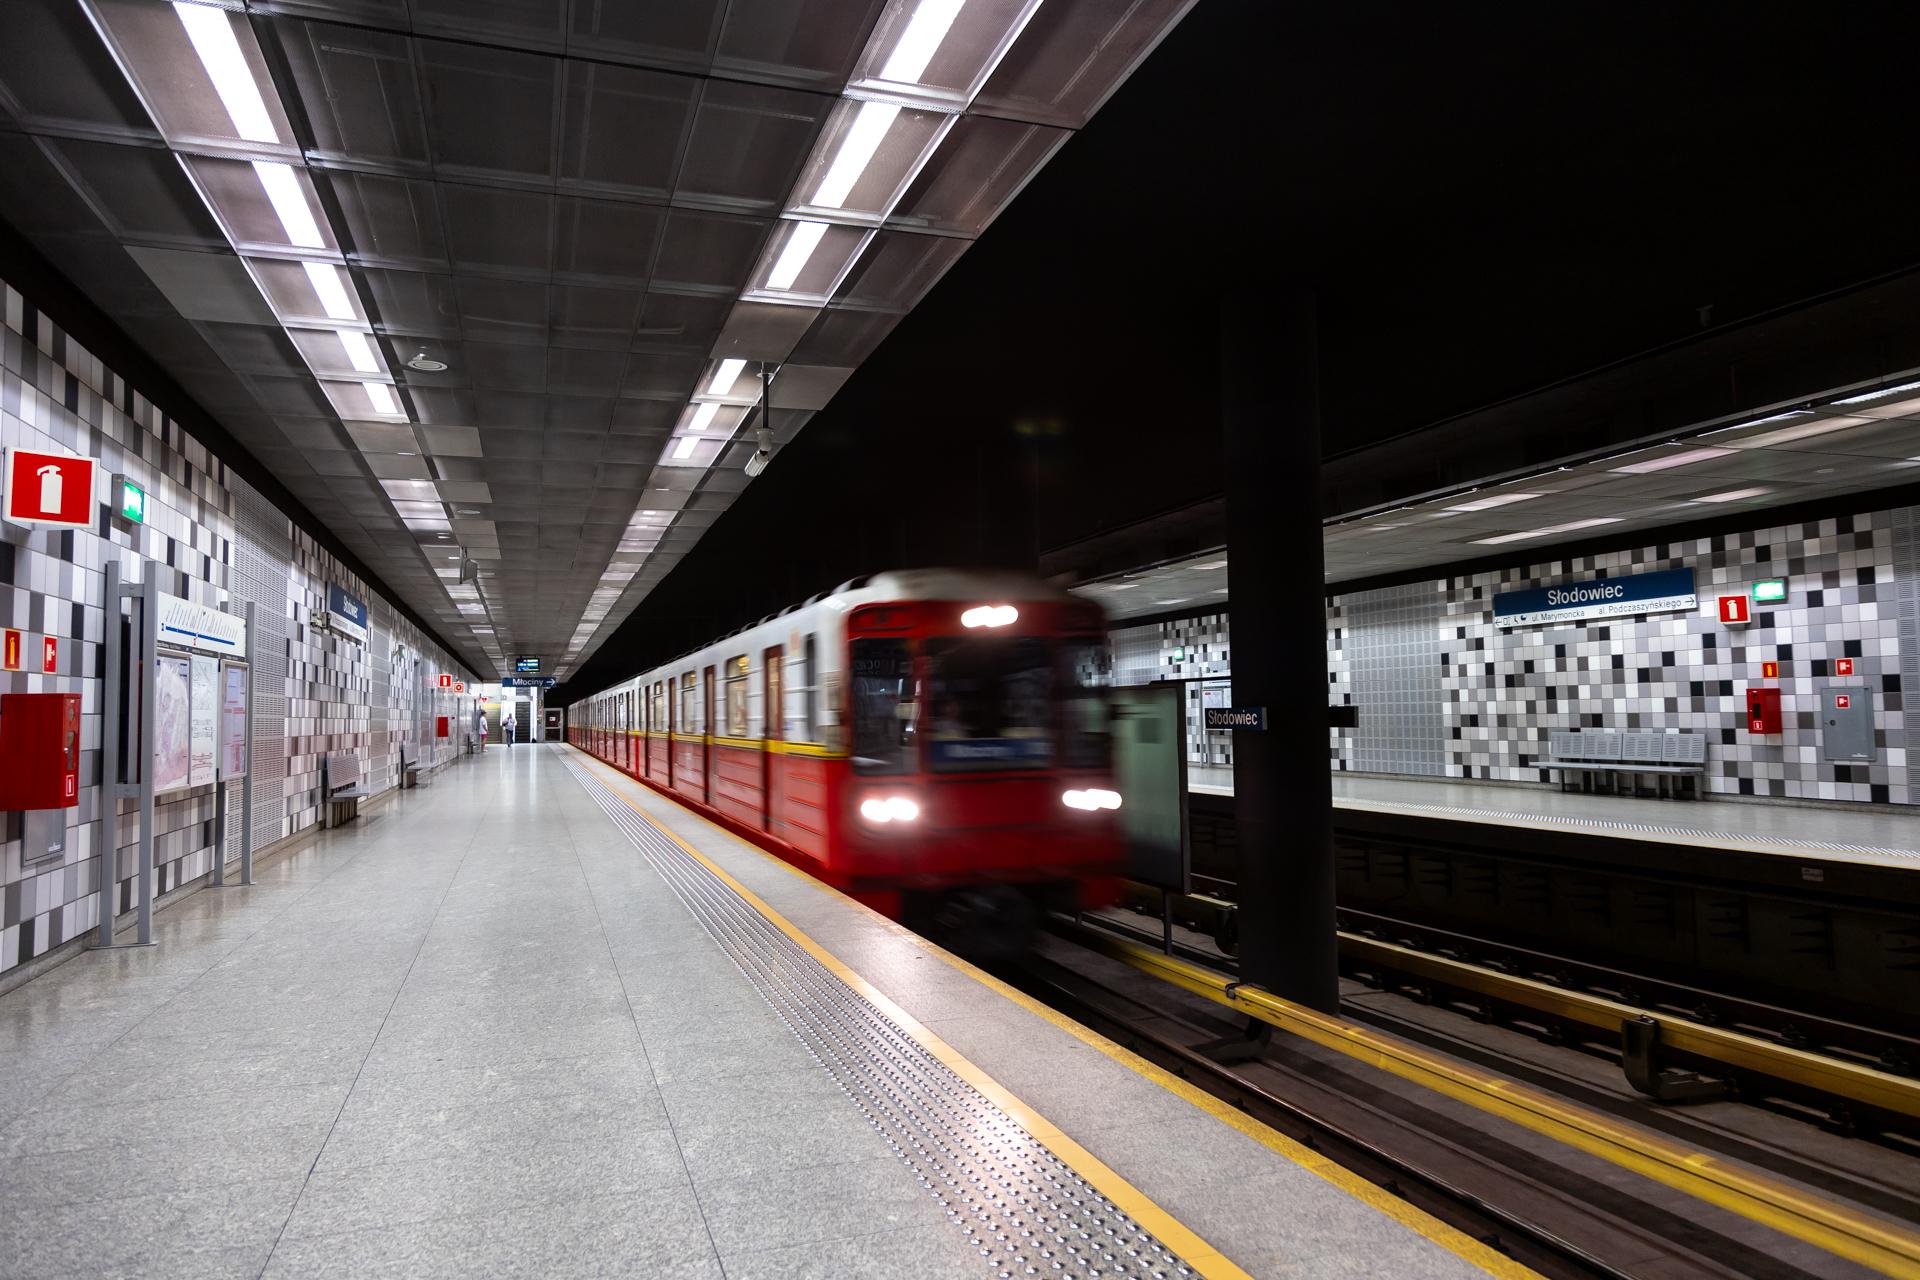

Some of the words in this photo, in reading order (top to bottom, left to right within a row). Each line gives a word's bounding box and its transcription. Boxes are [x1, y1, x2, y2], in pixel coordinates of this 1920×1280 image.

[1547, 584, 1624, 606] Słodowiec
[1608, 599, 1682, 614] Podczaszyńskiego
[1531, 612, 1540, 622] ul.
[1541, 609, 1585, 621] Marymoncka
[512, 678, 544, 686] Młociny
[1208, 709, 1258, 725] Słodowiec
